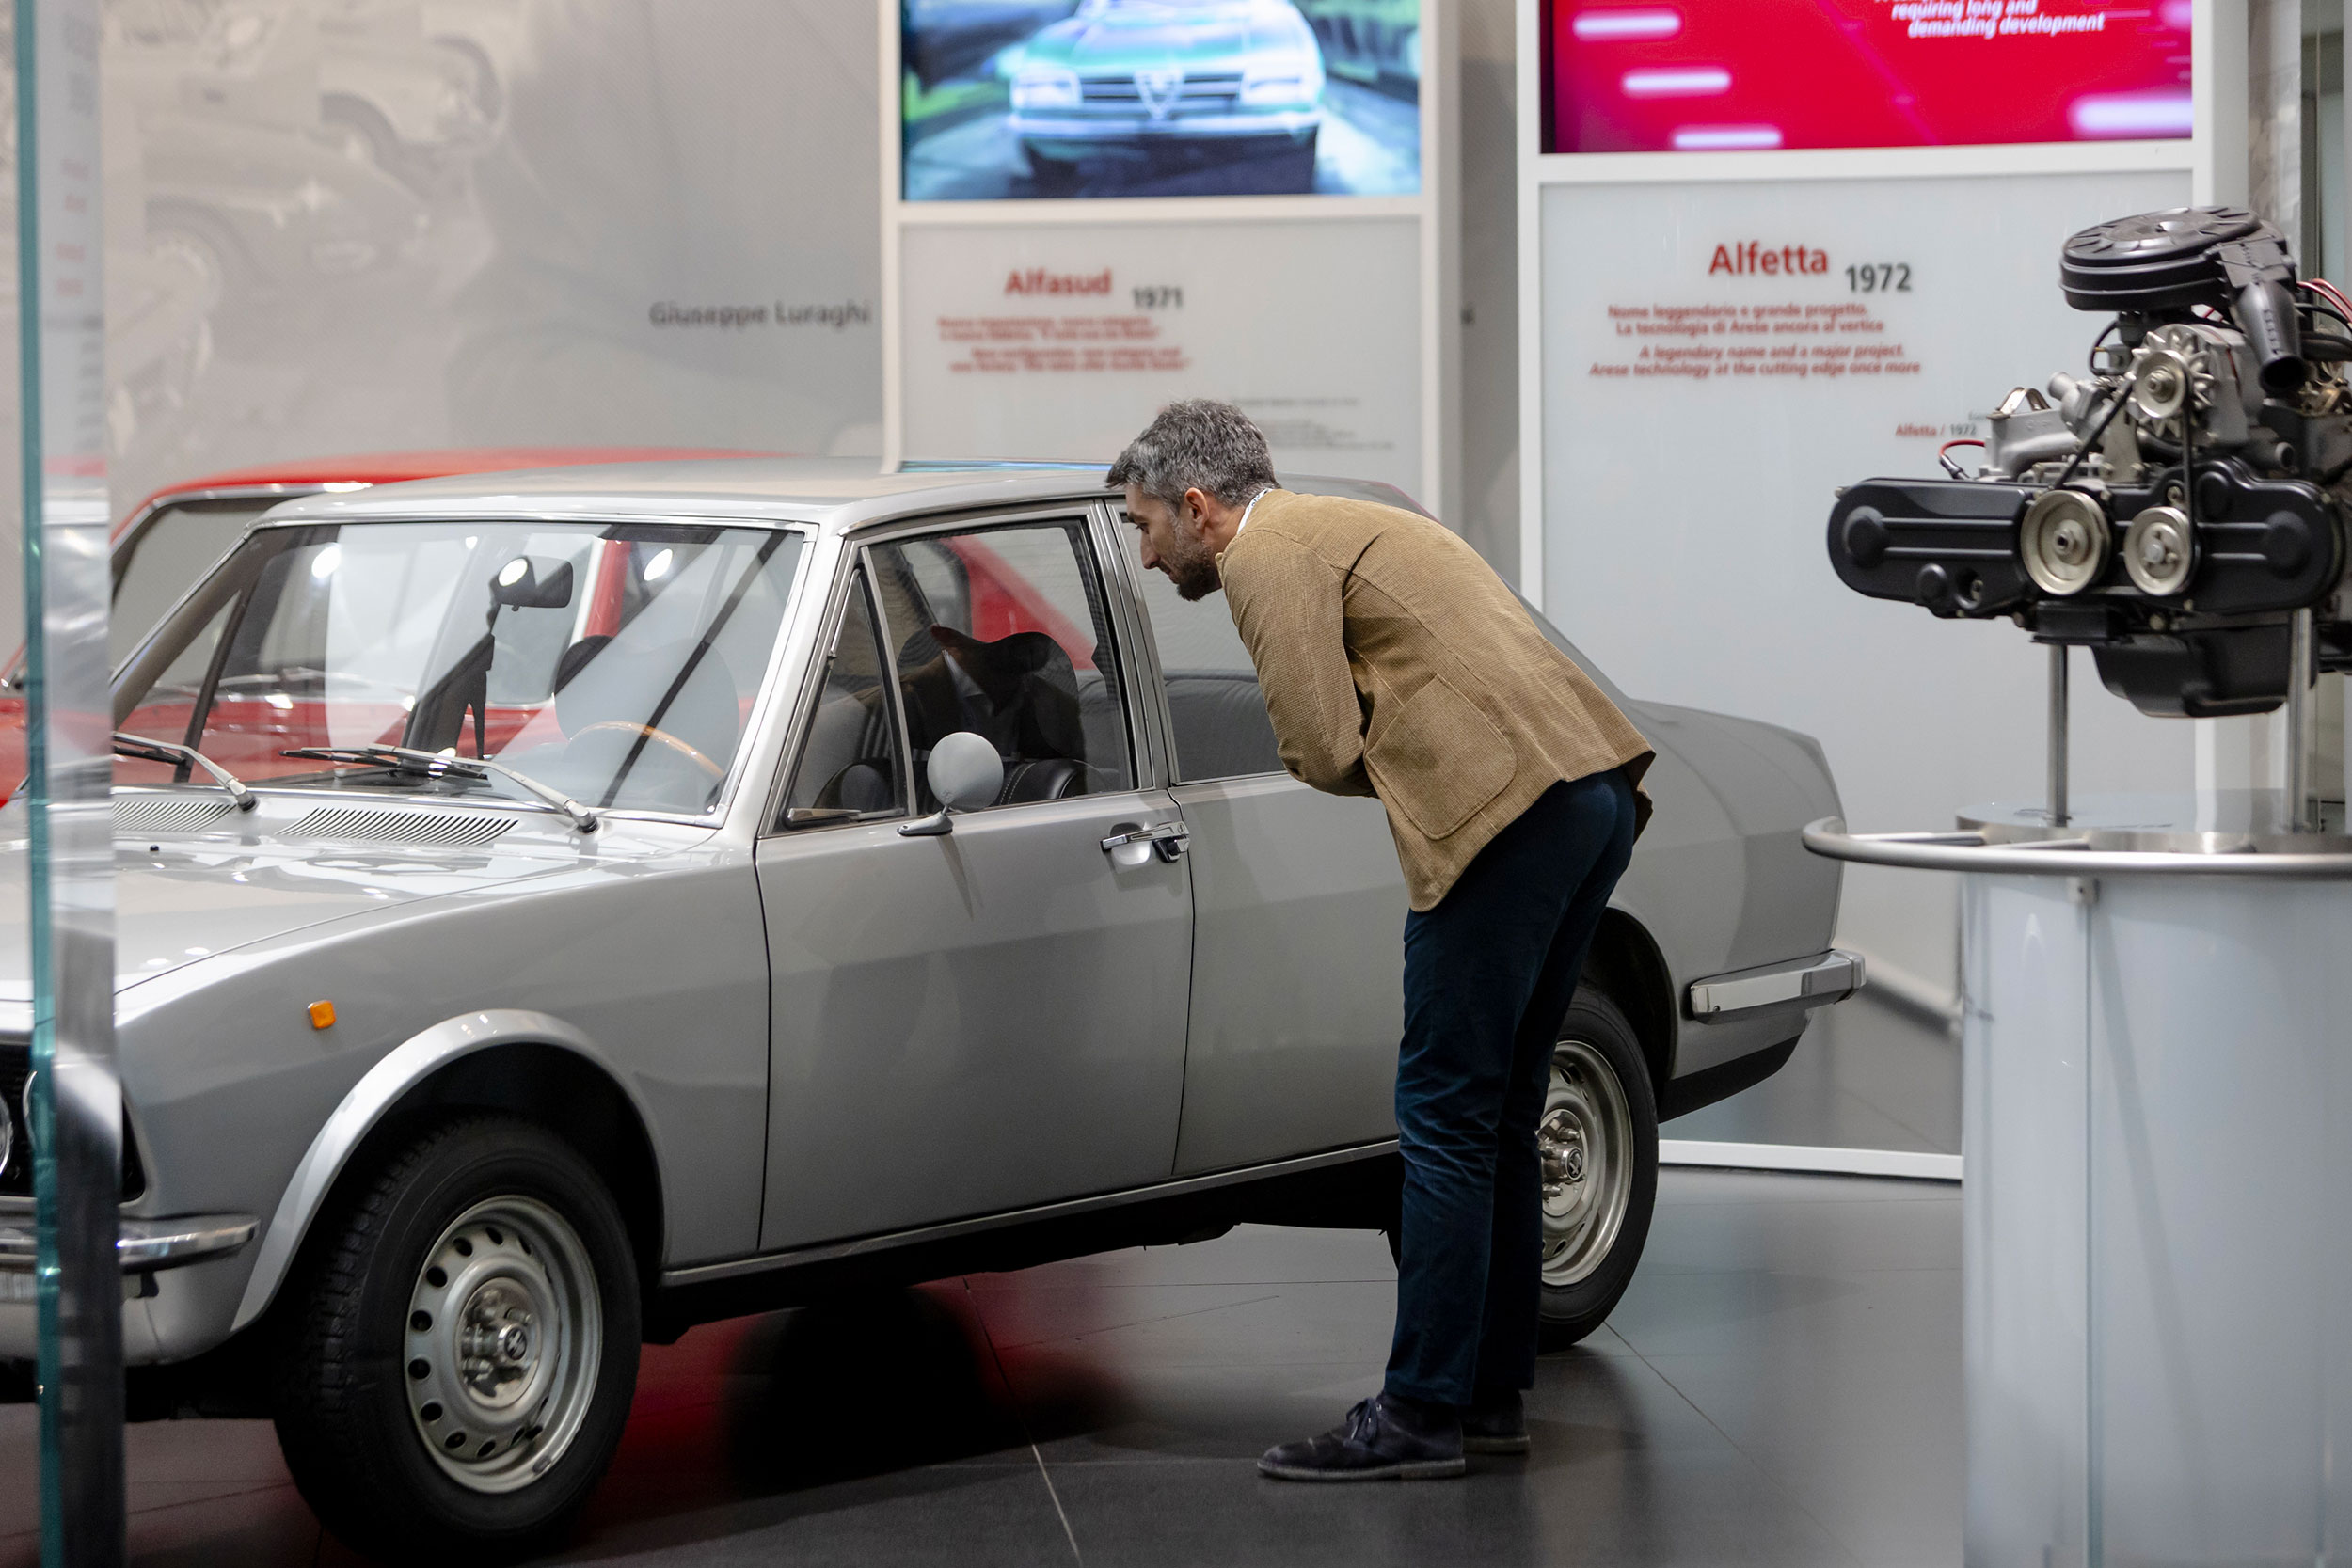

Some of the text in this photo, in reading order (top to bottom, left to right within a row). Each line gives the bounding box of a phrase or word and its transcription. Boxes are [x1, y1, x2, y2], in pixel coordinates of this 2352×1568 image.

[1891, 0, 2038, 20] requiring long and
[1908, 13, 2106, 39] demanding development
[1708, 241, 1912, 293] Alfetta 1972
[1004, 267, 1184, 309] Alfasud 1971
[649, 301, 767, 330] Giuseppe
[1608, 305, 1649, 318] Nome
[1740, 306, 1749, 316] e
[1753, 302, 1801, 318] grande
[1616, 322, 1632, 336] La
[1713, 321, 1725, 334] di
[1839, 320, 1884, 332] vertice
[1639, 345, 1650, 358] A
[1654, 344, 1724, 361] legendary
[1727, 346, 1766, 358] name
[1770, 344, 1797, 357] and
[1800, 347, 1807, 357] a
[1811, 344, 1851, 359] major
[1633, 361, 1710, 379] technology
[1714, 362, 1729, 375] at
[1733, 361, 1756, 374] the
[1759, 361, 1808, 377] cutting
[1811, 360, 1846, 377] edge
[1850, 362, 1882, 373] once
[1884, 362, 1921, 373] more
[1895, 422, 1937, 437] Alfetta
[1949, 423, 1978, 436] 1972
